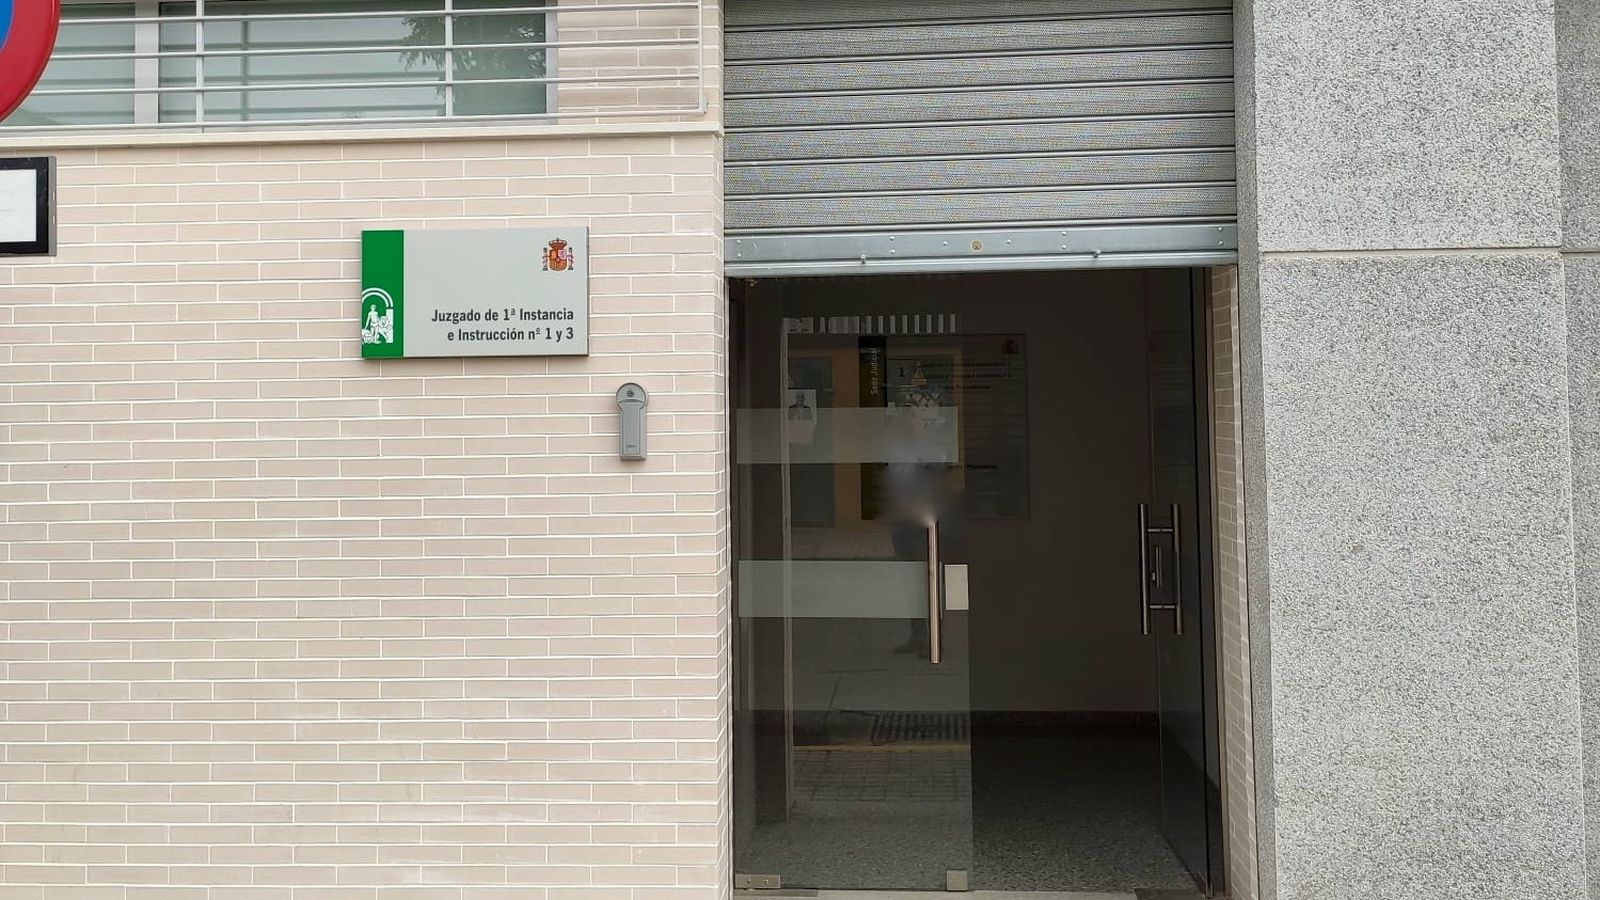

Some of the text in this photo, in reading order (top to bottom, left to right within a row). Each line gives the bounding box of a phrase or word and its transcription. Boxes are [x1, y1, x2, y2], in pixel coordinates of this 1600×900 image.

[432, 307, 574, 325] Juzgado de 1ª Instancia
[447, 326, 574, 343] e Instrucción nº 1 y 3
